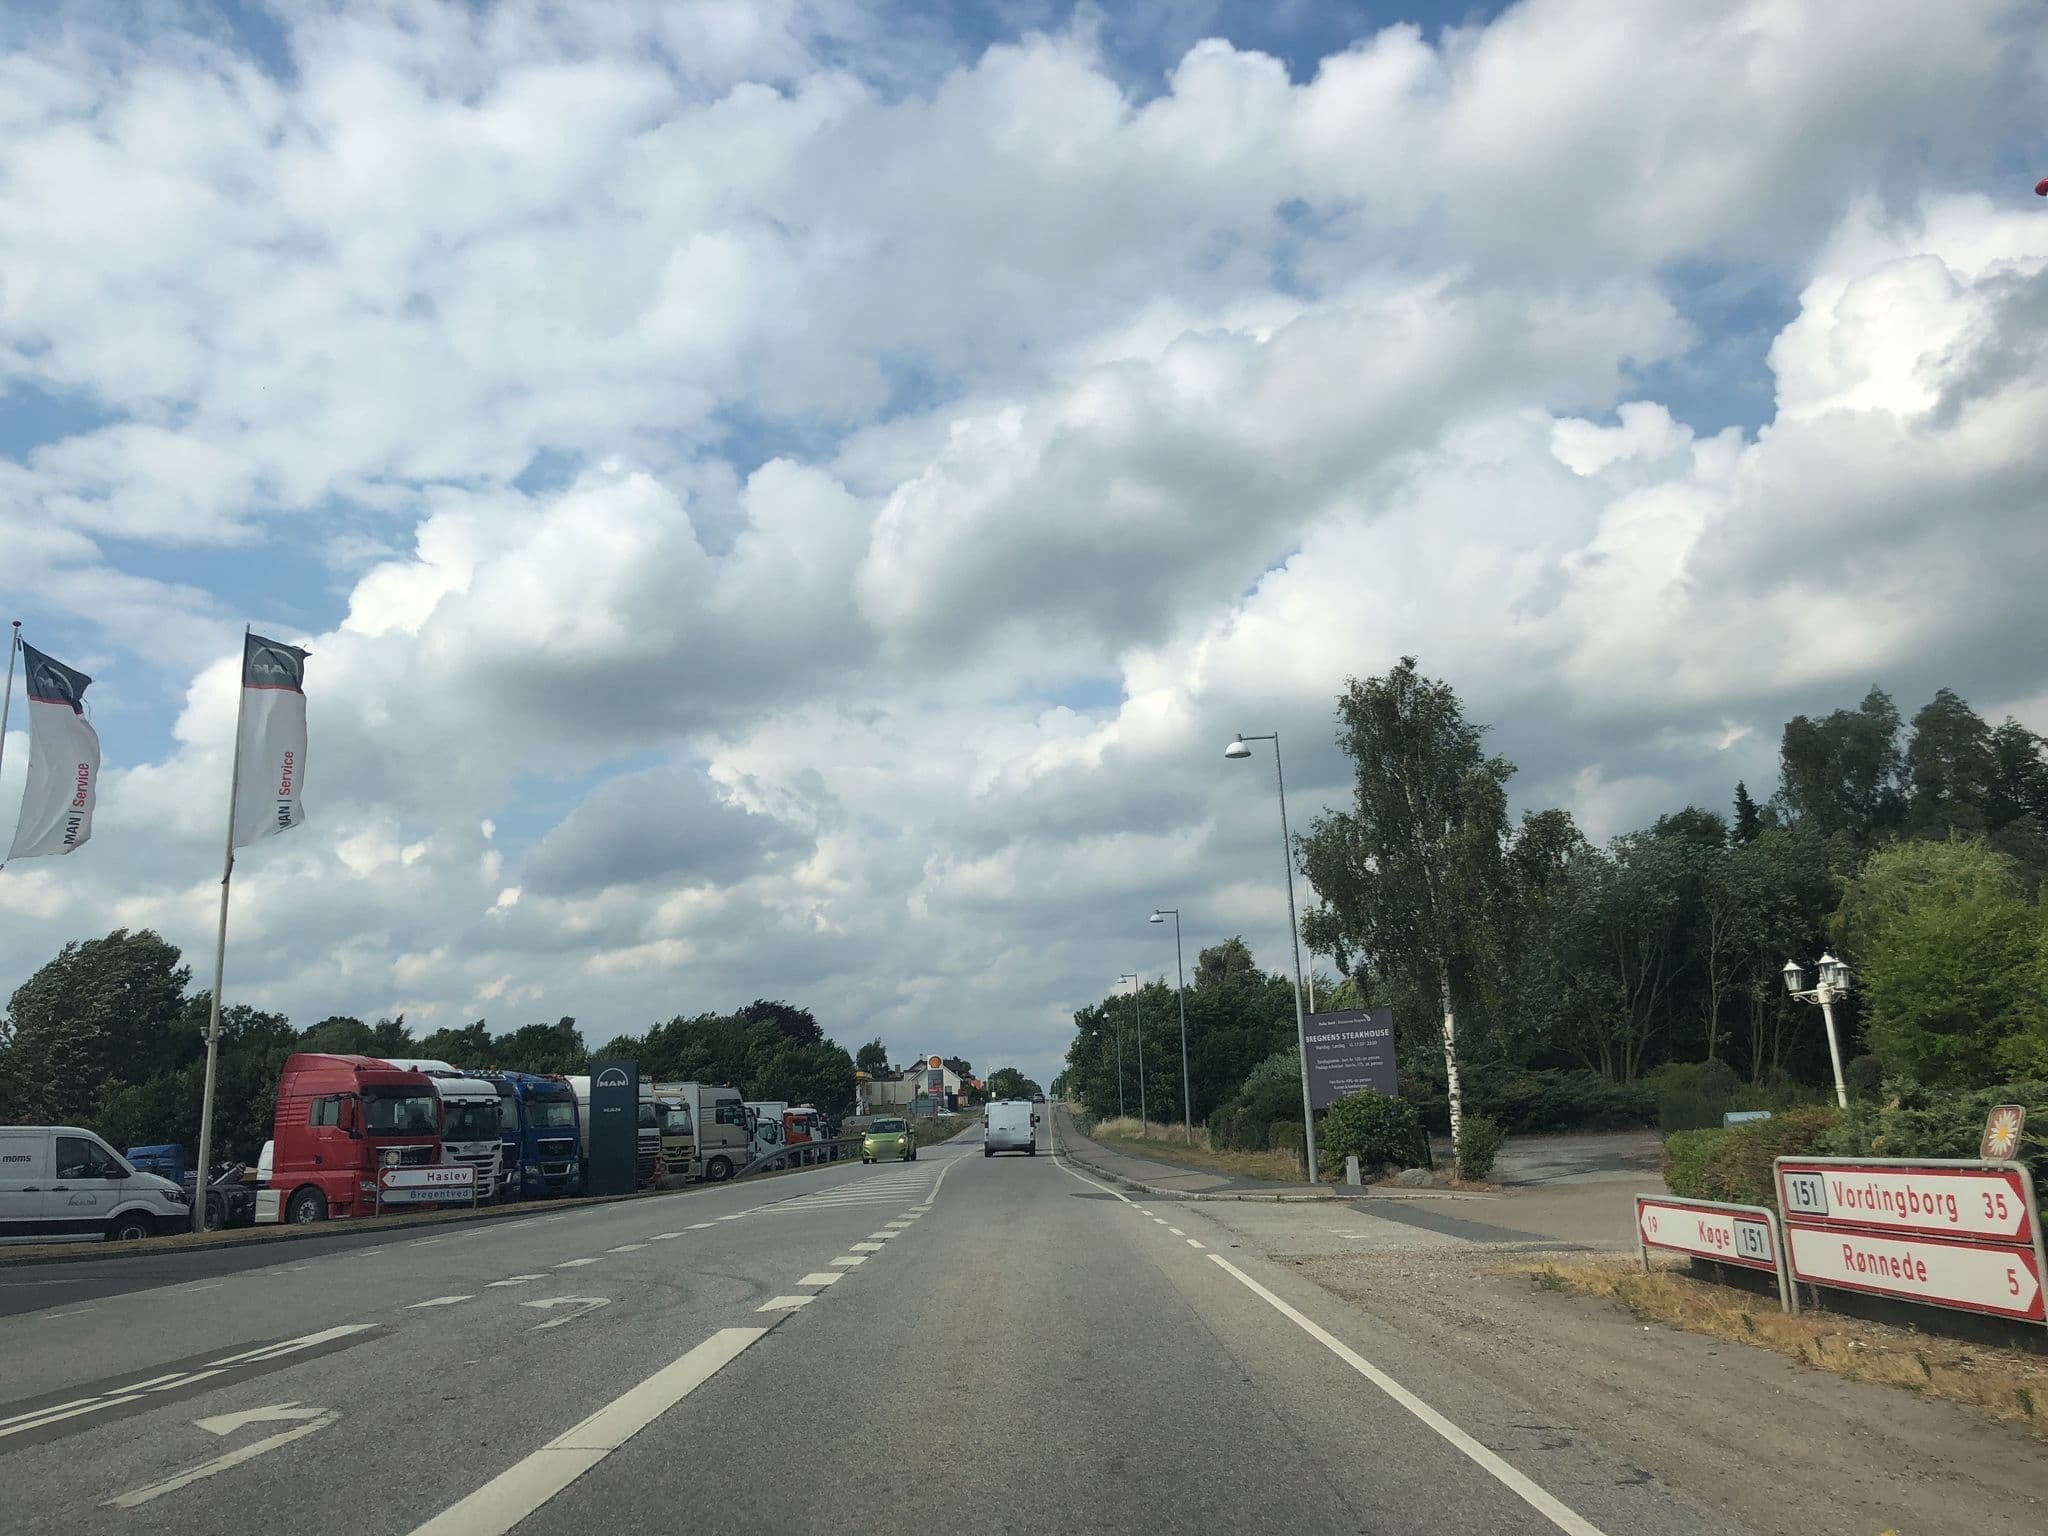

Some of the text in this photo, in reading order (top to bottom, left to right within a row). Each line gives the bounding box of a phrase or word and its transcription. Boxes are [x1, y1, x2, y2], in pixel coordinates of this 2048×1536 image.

[278, 751, 294, 796] Service
[64, 763, 90, 845] MAN Service
[1341, 1028, 1389, 1040] STEAKHOUSE
[2, 1154, 31, 1163] moms
[391, 1172, 468, 1183] 7 Haslev
[410, 1190, 469, 1199] Bregentved
[1793, 1180, 2008, 1222] 151 Vordingborg 35
[1648, 1215, 1763, 1253] 19 Køge 151
[1842, 1243, 2019, 1296] Rønnede 5
